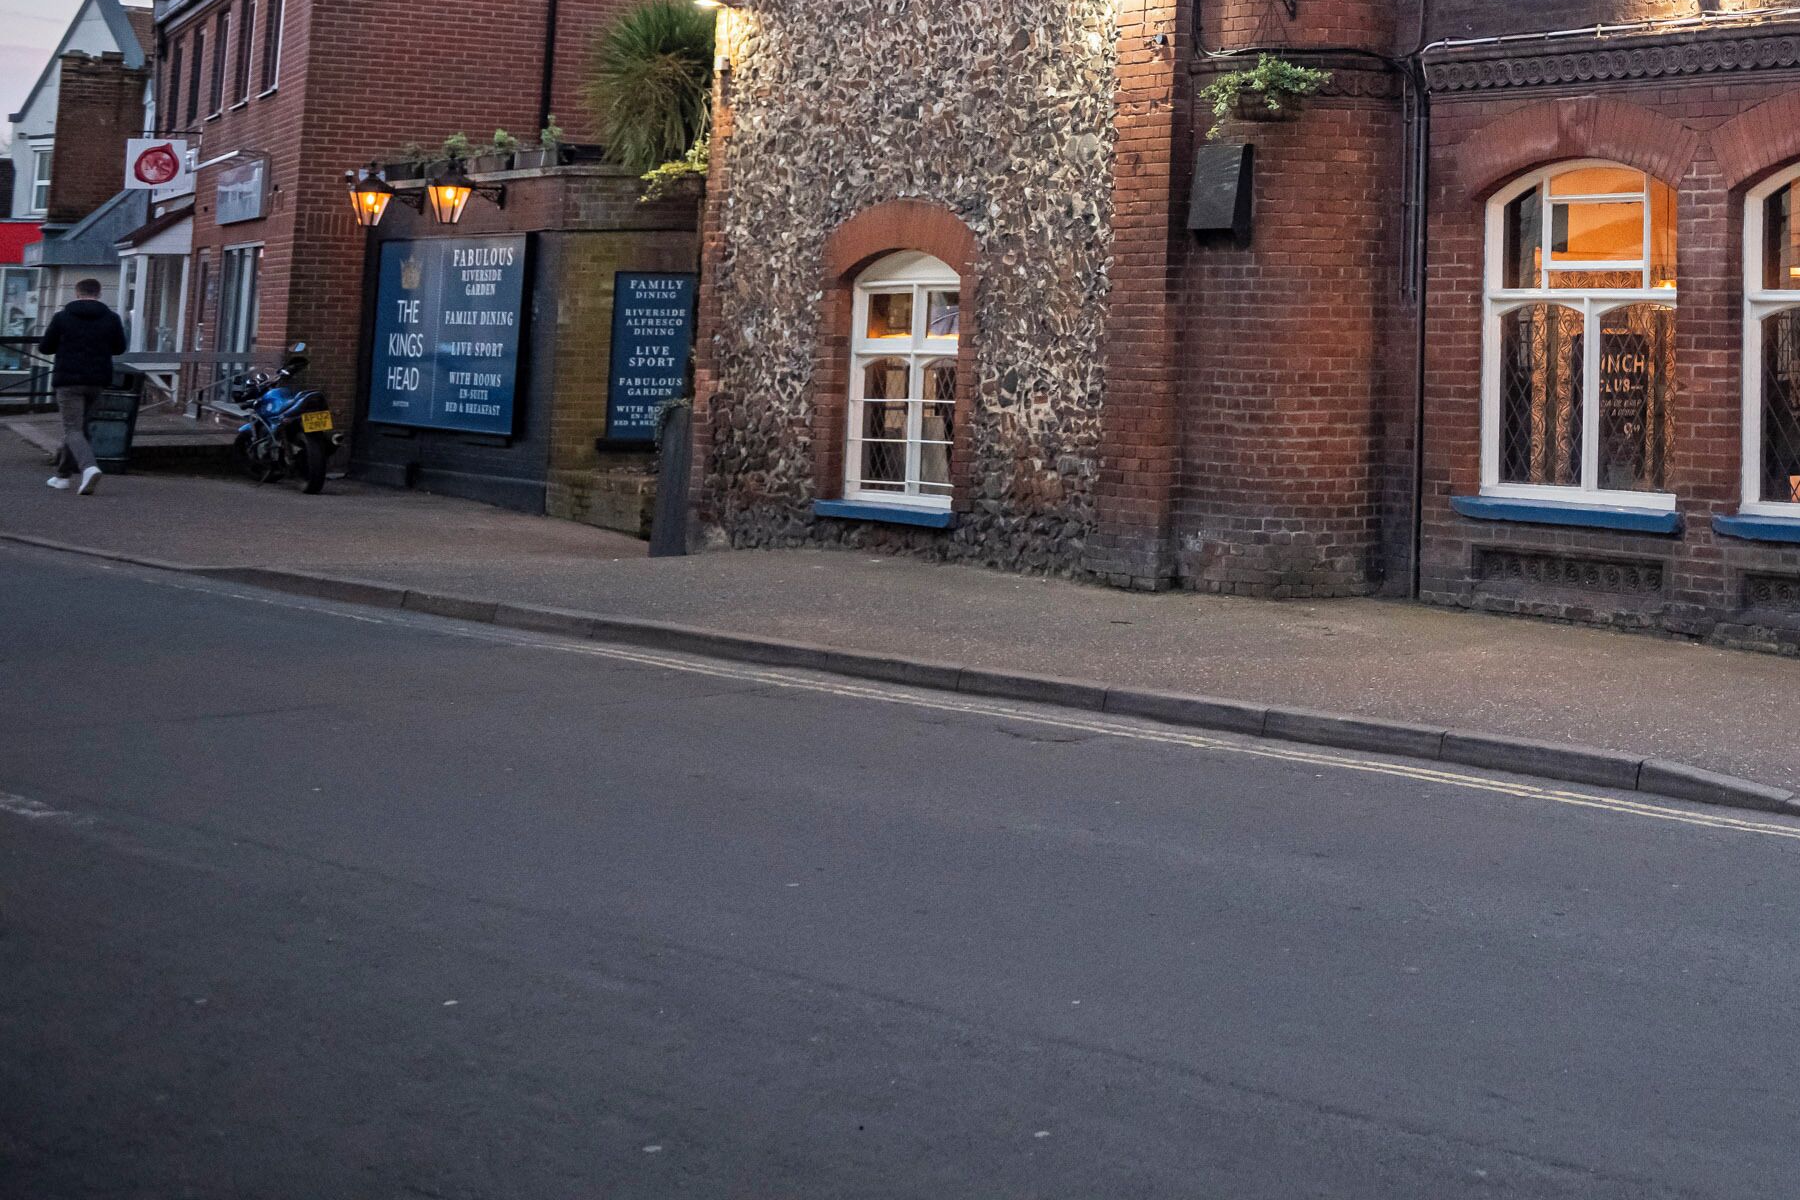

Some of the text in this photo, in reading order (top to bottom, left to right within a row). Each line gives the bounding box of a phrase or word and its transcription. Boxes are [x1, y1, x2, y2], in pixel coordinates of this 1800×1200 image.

[453, 247, 514, 267] FABULOUS
[461, 269, 502, 282] RIVERSIDE
[465, 283, 496, 296] GARDEN
[629, 280, 684, 290] FAMILY
[635, 291, 677, 299] DINING
[397, 300, 420, 324] THE
[625, 309, 686, 317] RIVERSIDE
[445, 311, 514, 326] FAMILY DINING
[625, 318, 683, 326] ALFRESCO
[633, 328, 675, 336] DINING
[388, 333, 424, 358] KINGS
[450, 341, 504, 357] LIVE SPORT
[636, 346, 670, 356] LIVE
[628, 357, 676, 367] SPORT
[387, 366, 420, 391] HEAD
[449, 371, 502, 387] WITH ROOMS
[618, 377, 683, 386] FABULOUS
[627, 388, 672, 396] GARDEN
[616, 405, 644, 413] WITH
